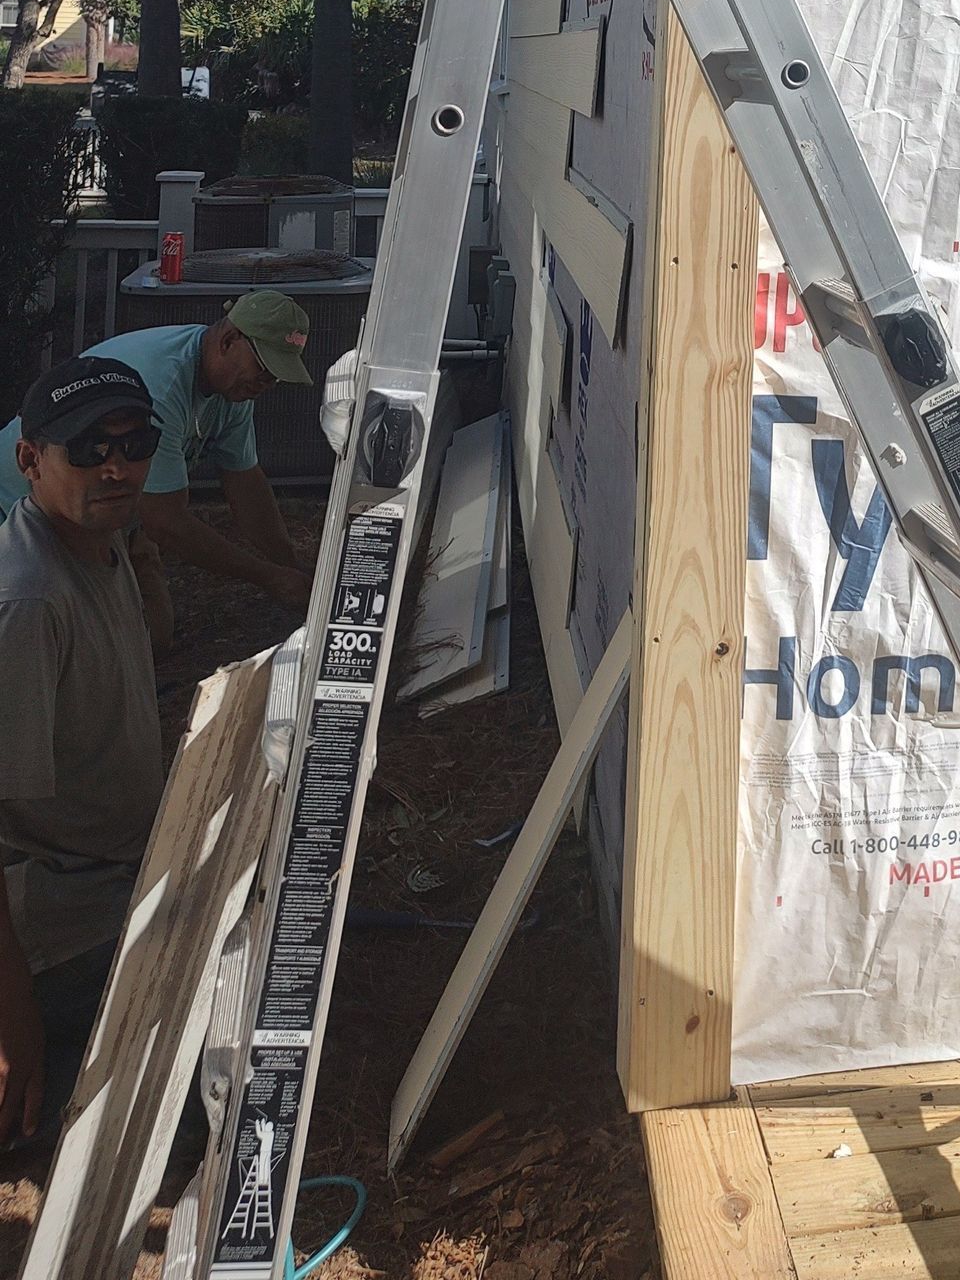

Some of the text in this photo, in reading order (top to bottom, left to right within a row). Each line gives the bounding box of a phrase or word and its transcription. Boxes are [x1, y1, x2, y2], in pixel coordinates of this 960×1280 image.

[51, 377, 100, 402] Buenas
[328, 650, 353, 658] LOAD
[328, 657, 372, 666] CAPACITY
[325, 666, 350, 676] TYPE
[744, 636, 956, 721] Hom
[811, 839, 844, 855] Call
